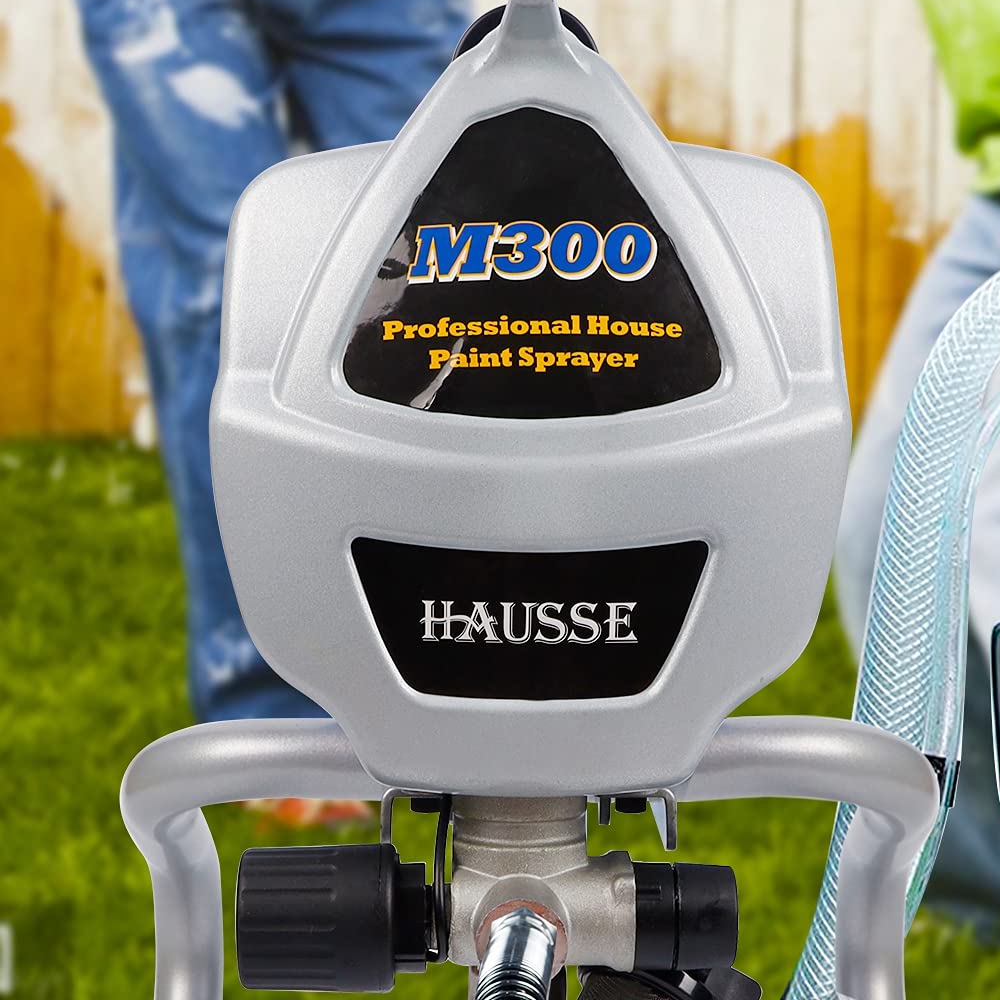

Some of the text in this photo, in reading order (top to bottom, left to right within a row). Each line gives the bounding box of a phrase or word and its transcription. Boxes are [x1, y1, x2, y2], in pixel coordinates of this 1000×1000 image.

[407, 220, 657, 284] M300
[382, 315, 683, 341] Professional House
[429, 347, 639, 372] Paint Sprayer
[419, 599, 639, 645] HAUSSE
